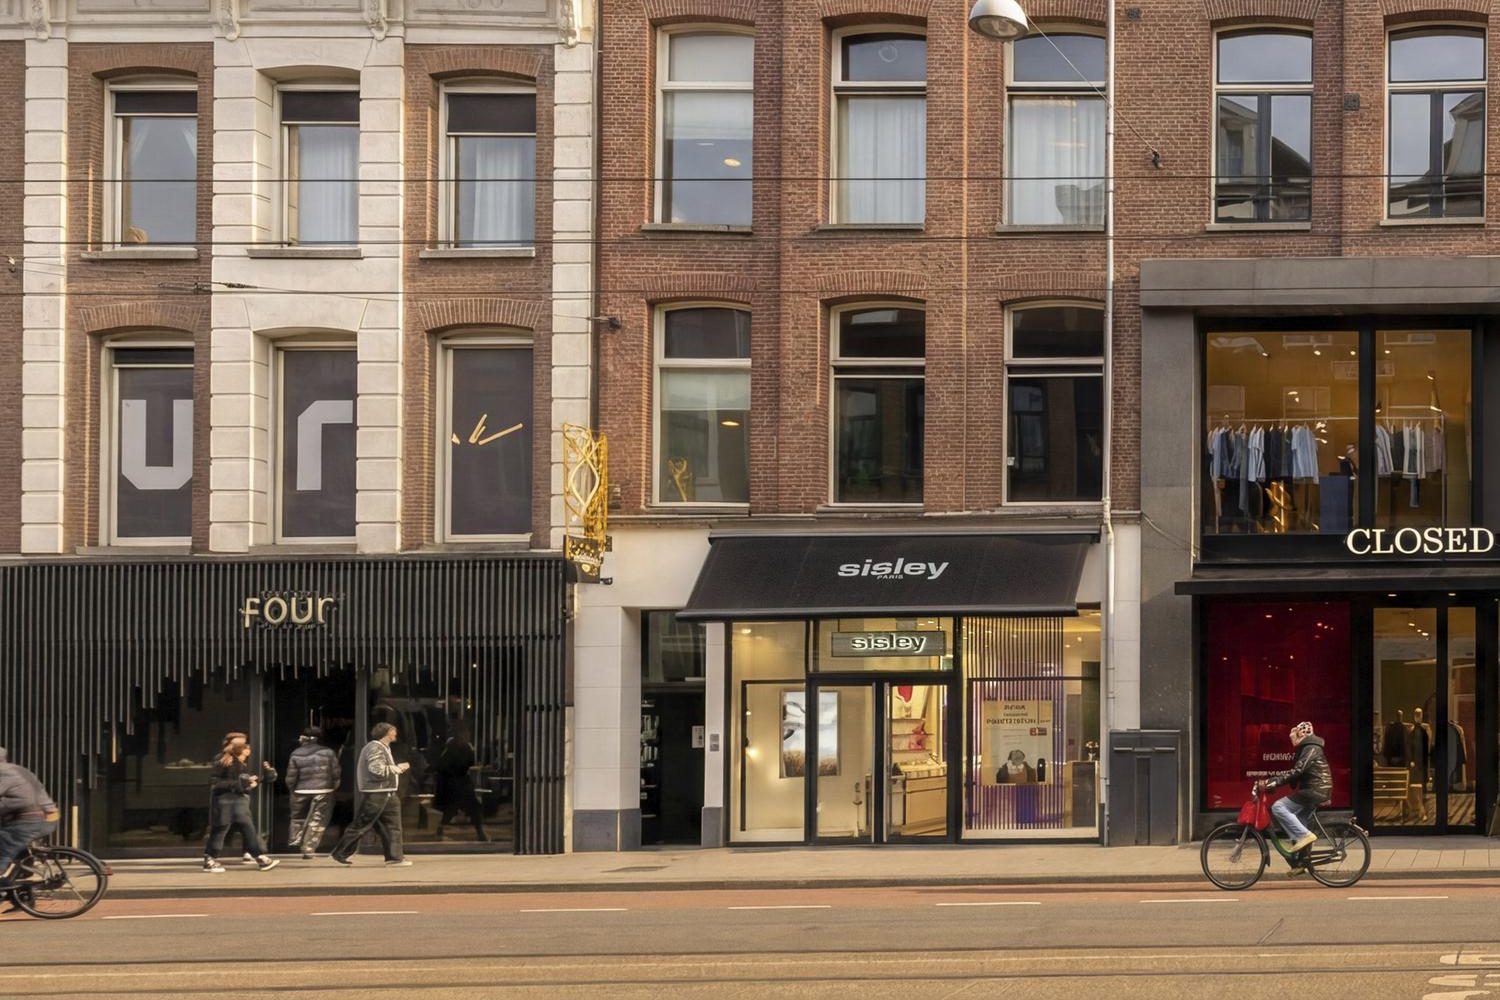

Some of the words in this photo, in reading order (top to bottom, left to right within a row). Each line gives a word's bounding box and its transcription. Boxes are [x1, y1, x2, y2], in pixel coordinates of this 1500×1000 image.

[1346, 527, 1495, 555] CLOSED
[837, 557, 949, 580] sisley
[851, 633, 927, 654] sisley
